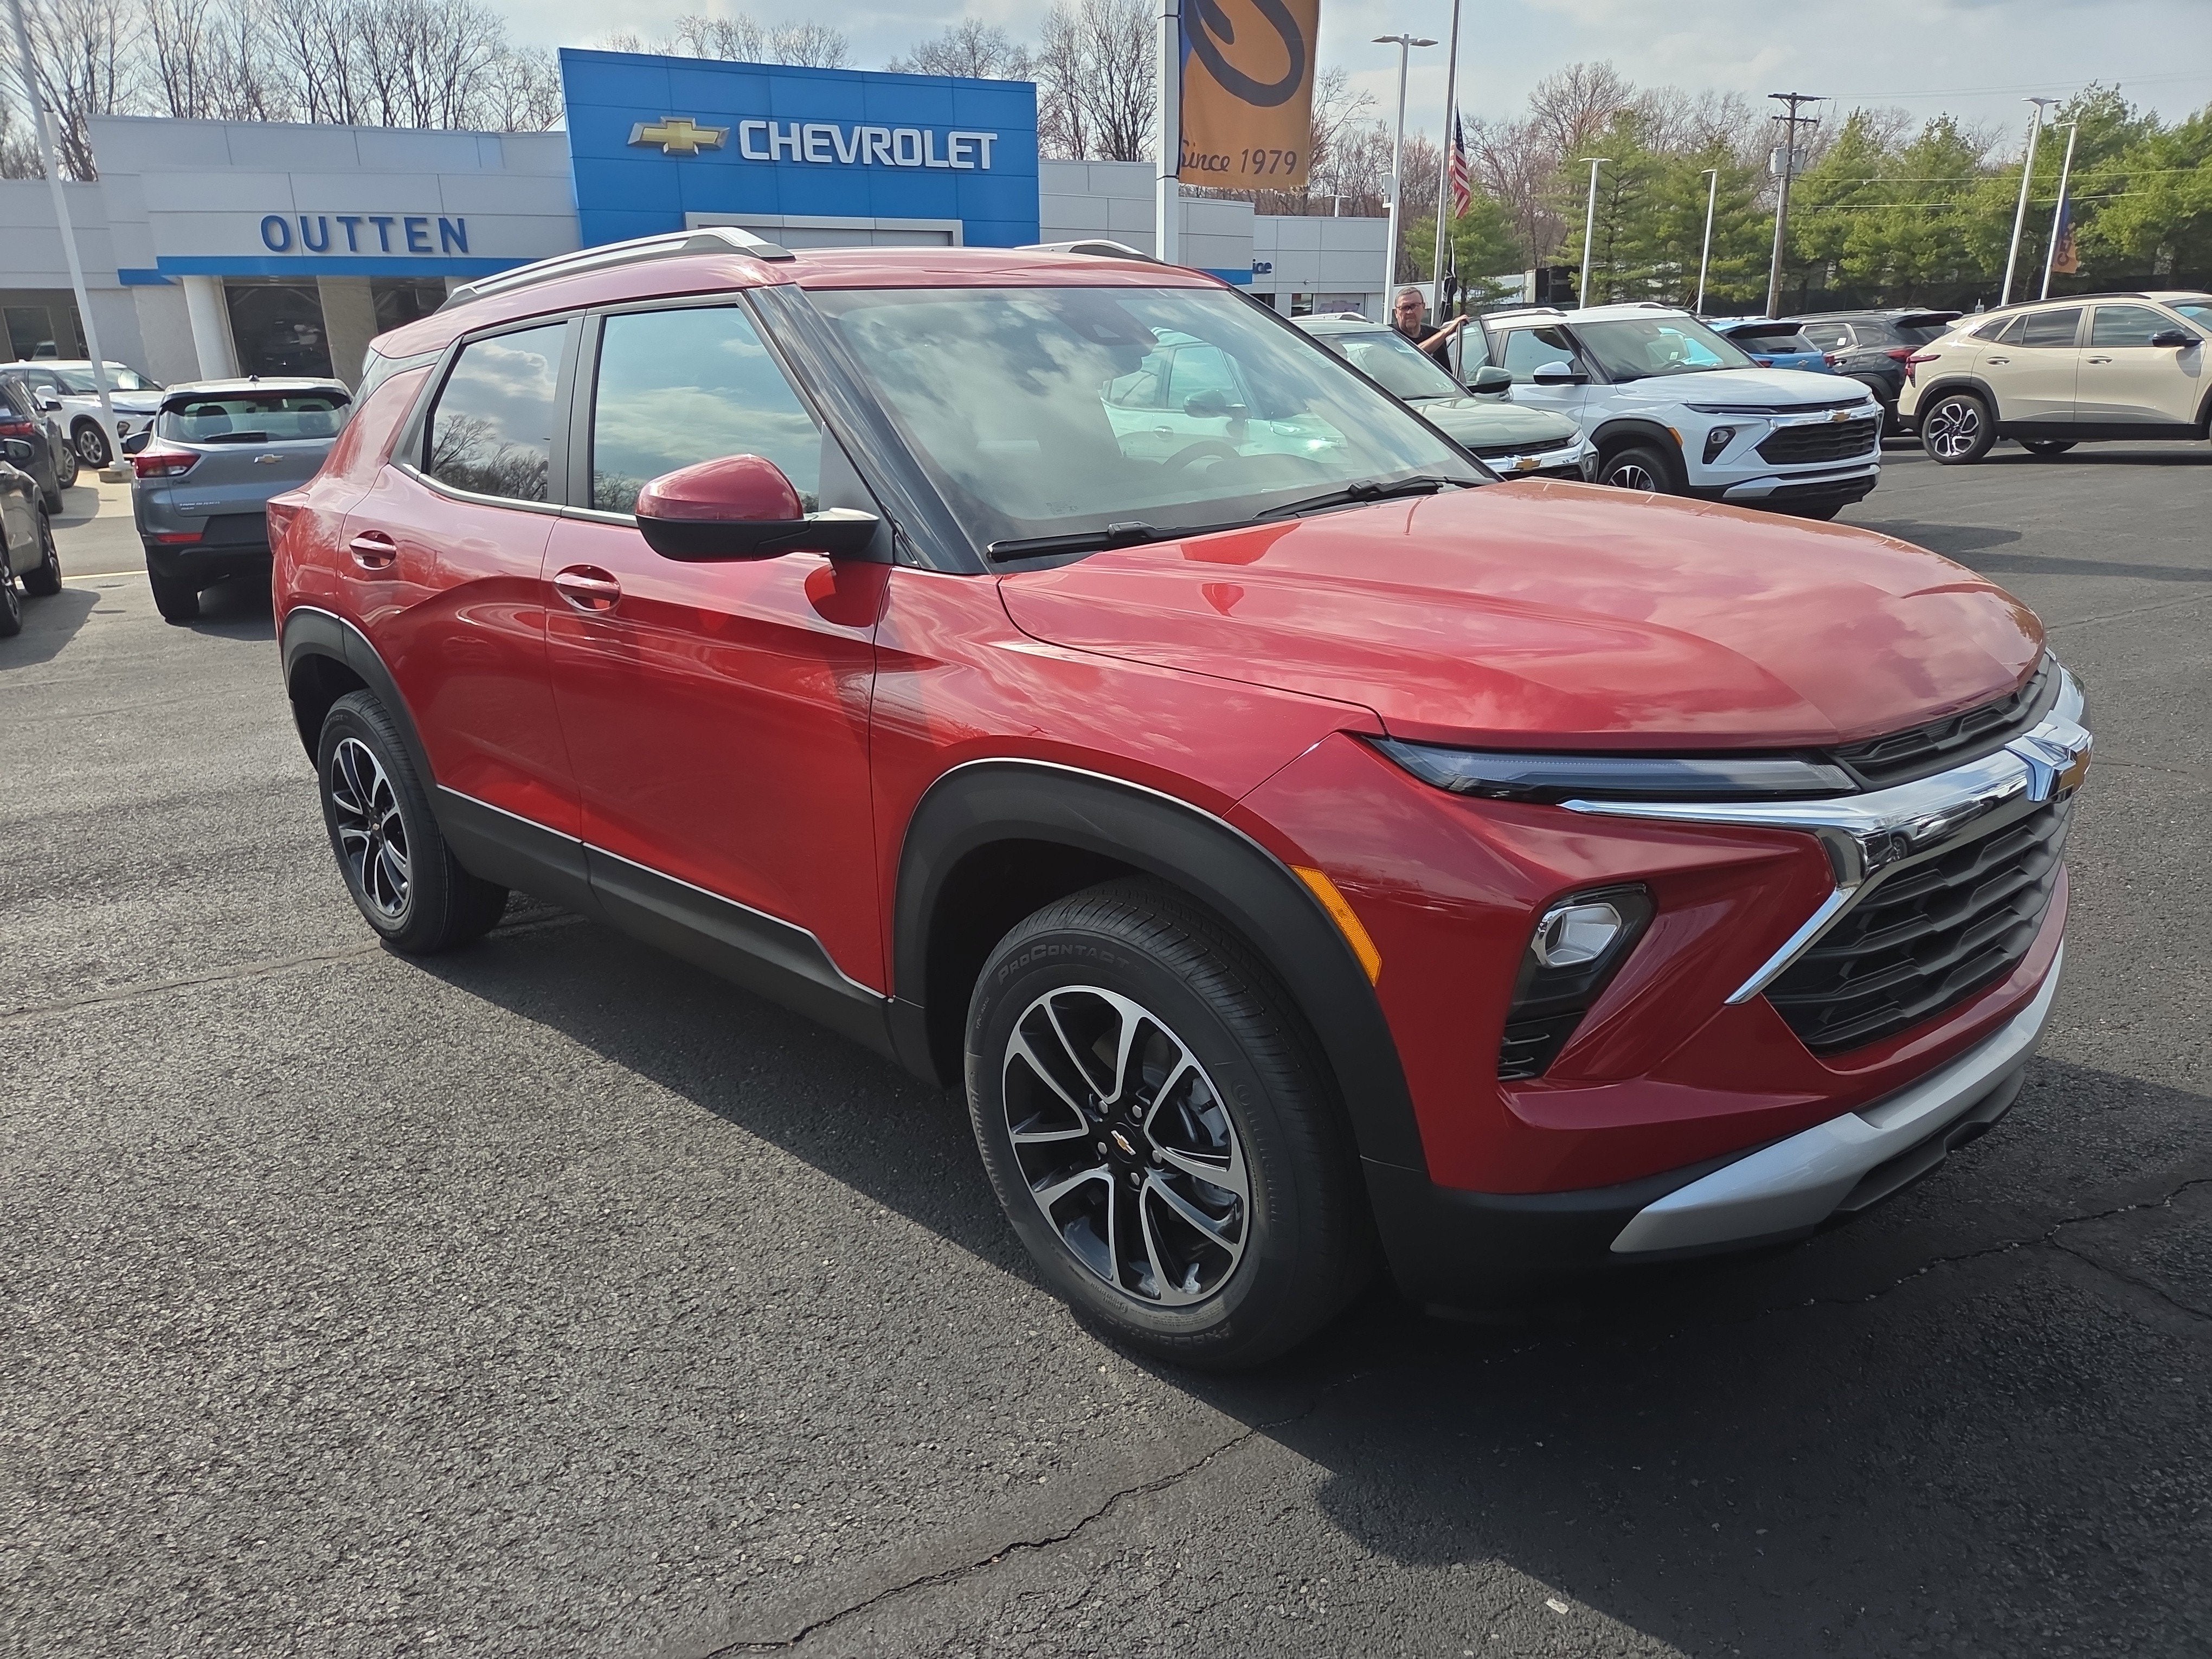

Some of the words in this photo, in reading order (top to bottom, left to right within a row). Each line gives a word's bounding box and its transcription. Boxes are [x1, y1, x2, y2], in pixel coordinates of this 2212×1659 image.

[739, 120, 998, 170] CHEVROLET
[1241, 148, 1297, 181] 1979
[261, 215, 469, 254] OUTTEN
